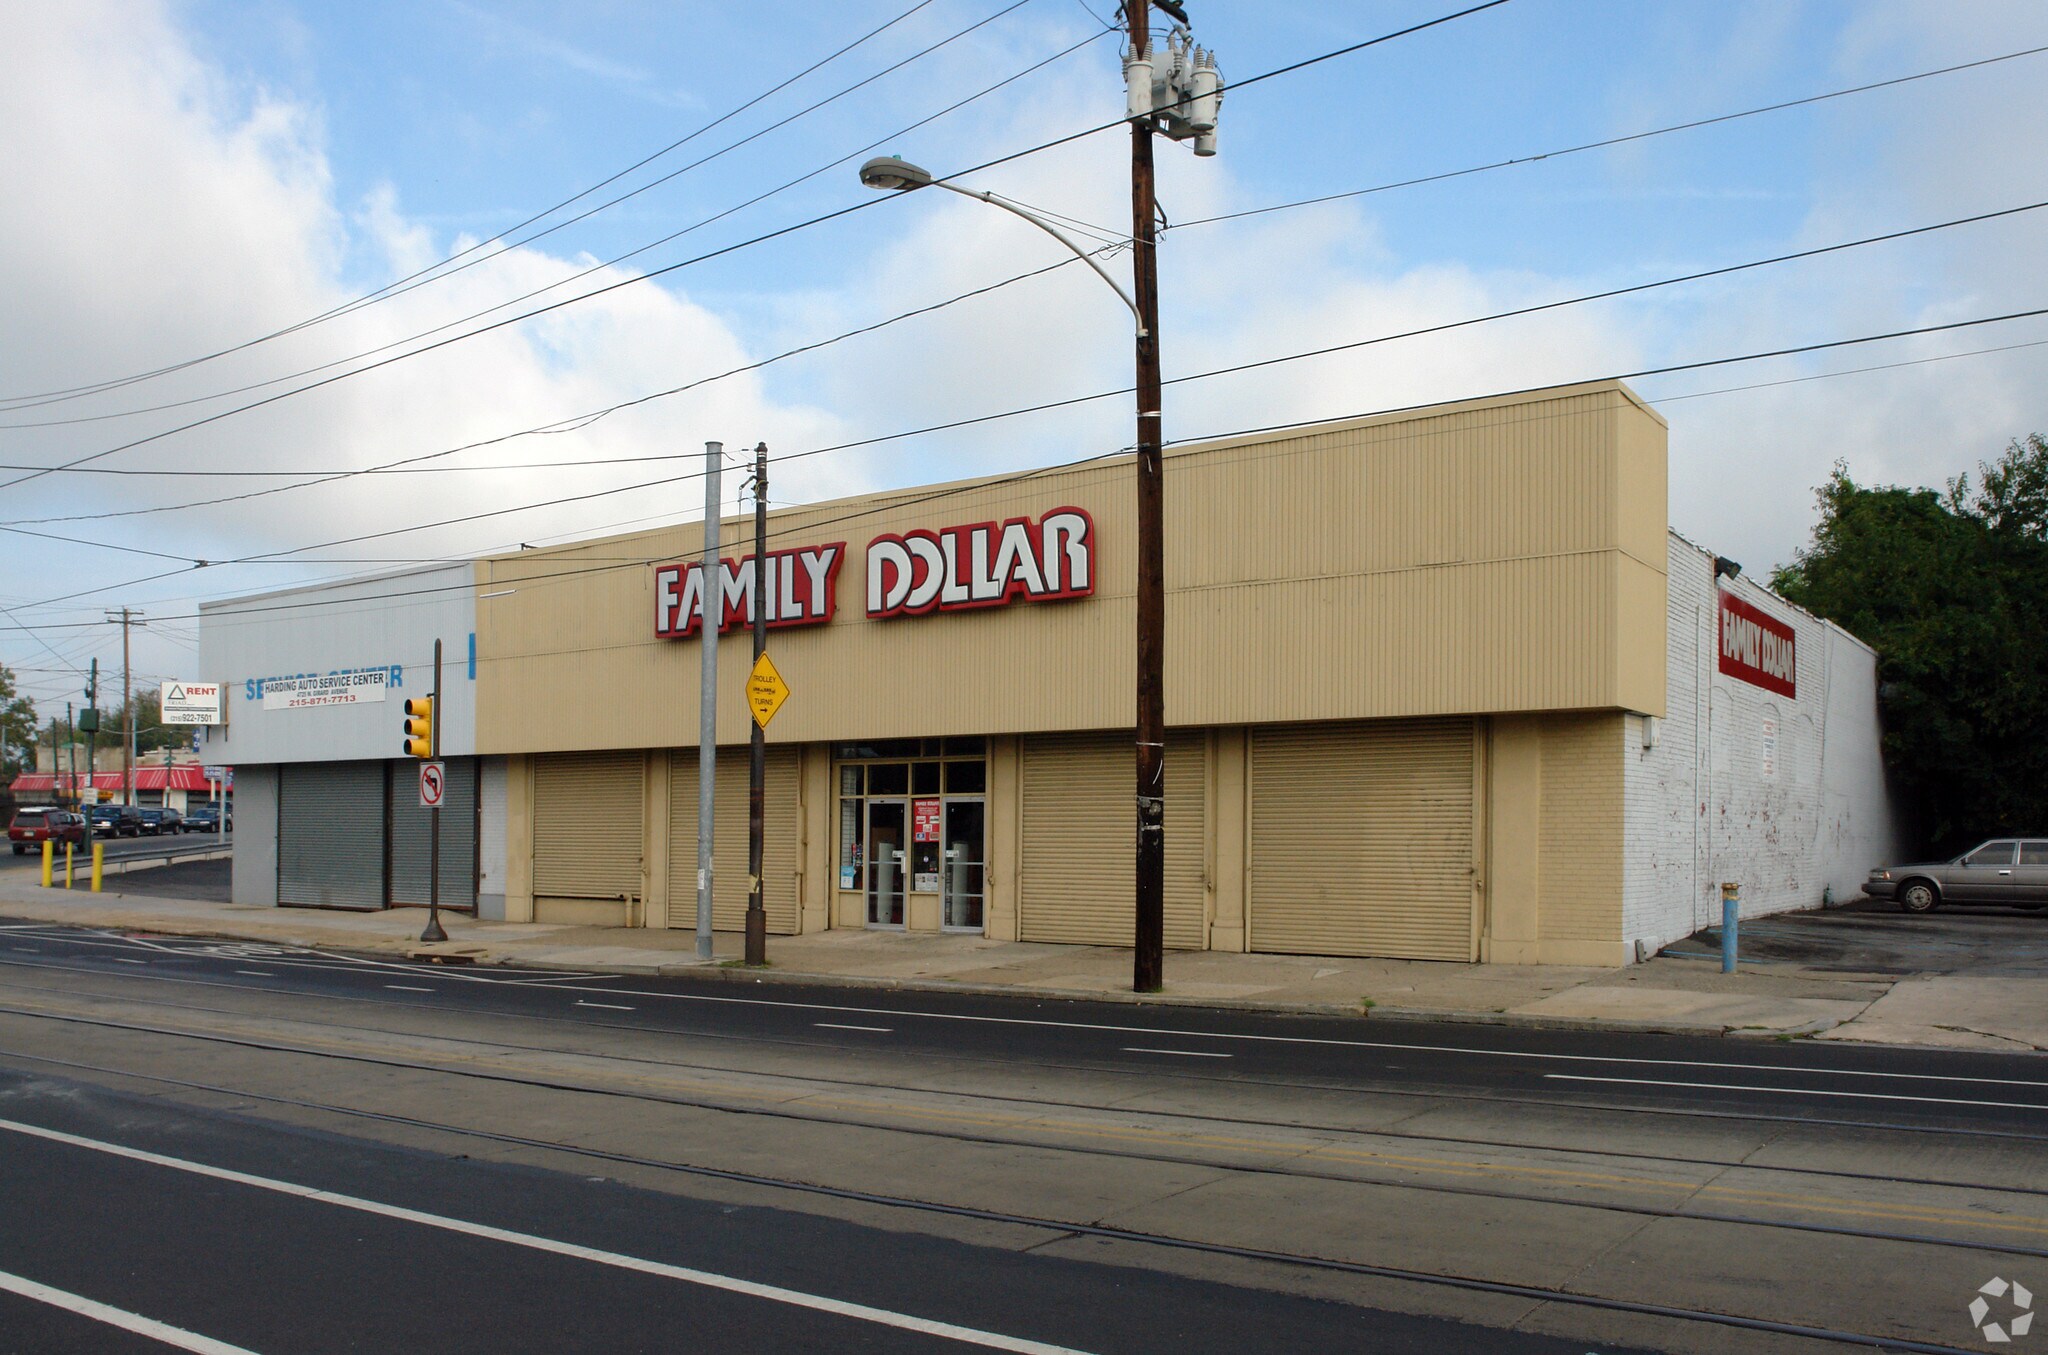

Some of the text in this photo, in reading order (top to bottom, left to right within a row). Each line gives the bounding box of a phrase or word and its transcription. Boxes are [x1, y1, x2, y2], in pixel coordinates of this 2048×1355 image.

[656, 513, 1089, 633] FAMILY DOLLAR
[1723, 608, 1794, 684] FAMILY DOLLAR
[264, 672, 385, 694] HARDING AUTO SERVICE CENTER
[753, 675, 776, 683] TROLLEY
[186, 687, 217, 696] RENT
[289, 695, 356, 706] 215-871-7713
